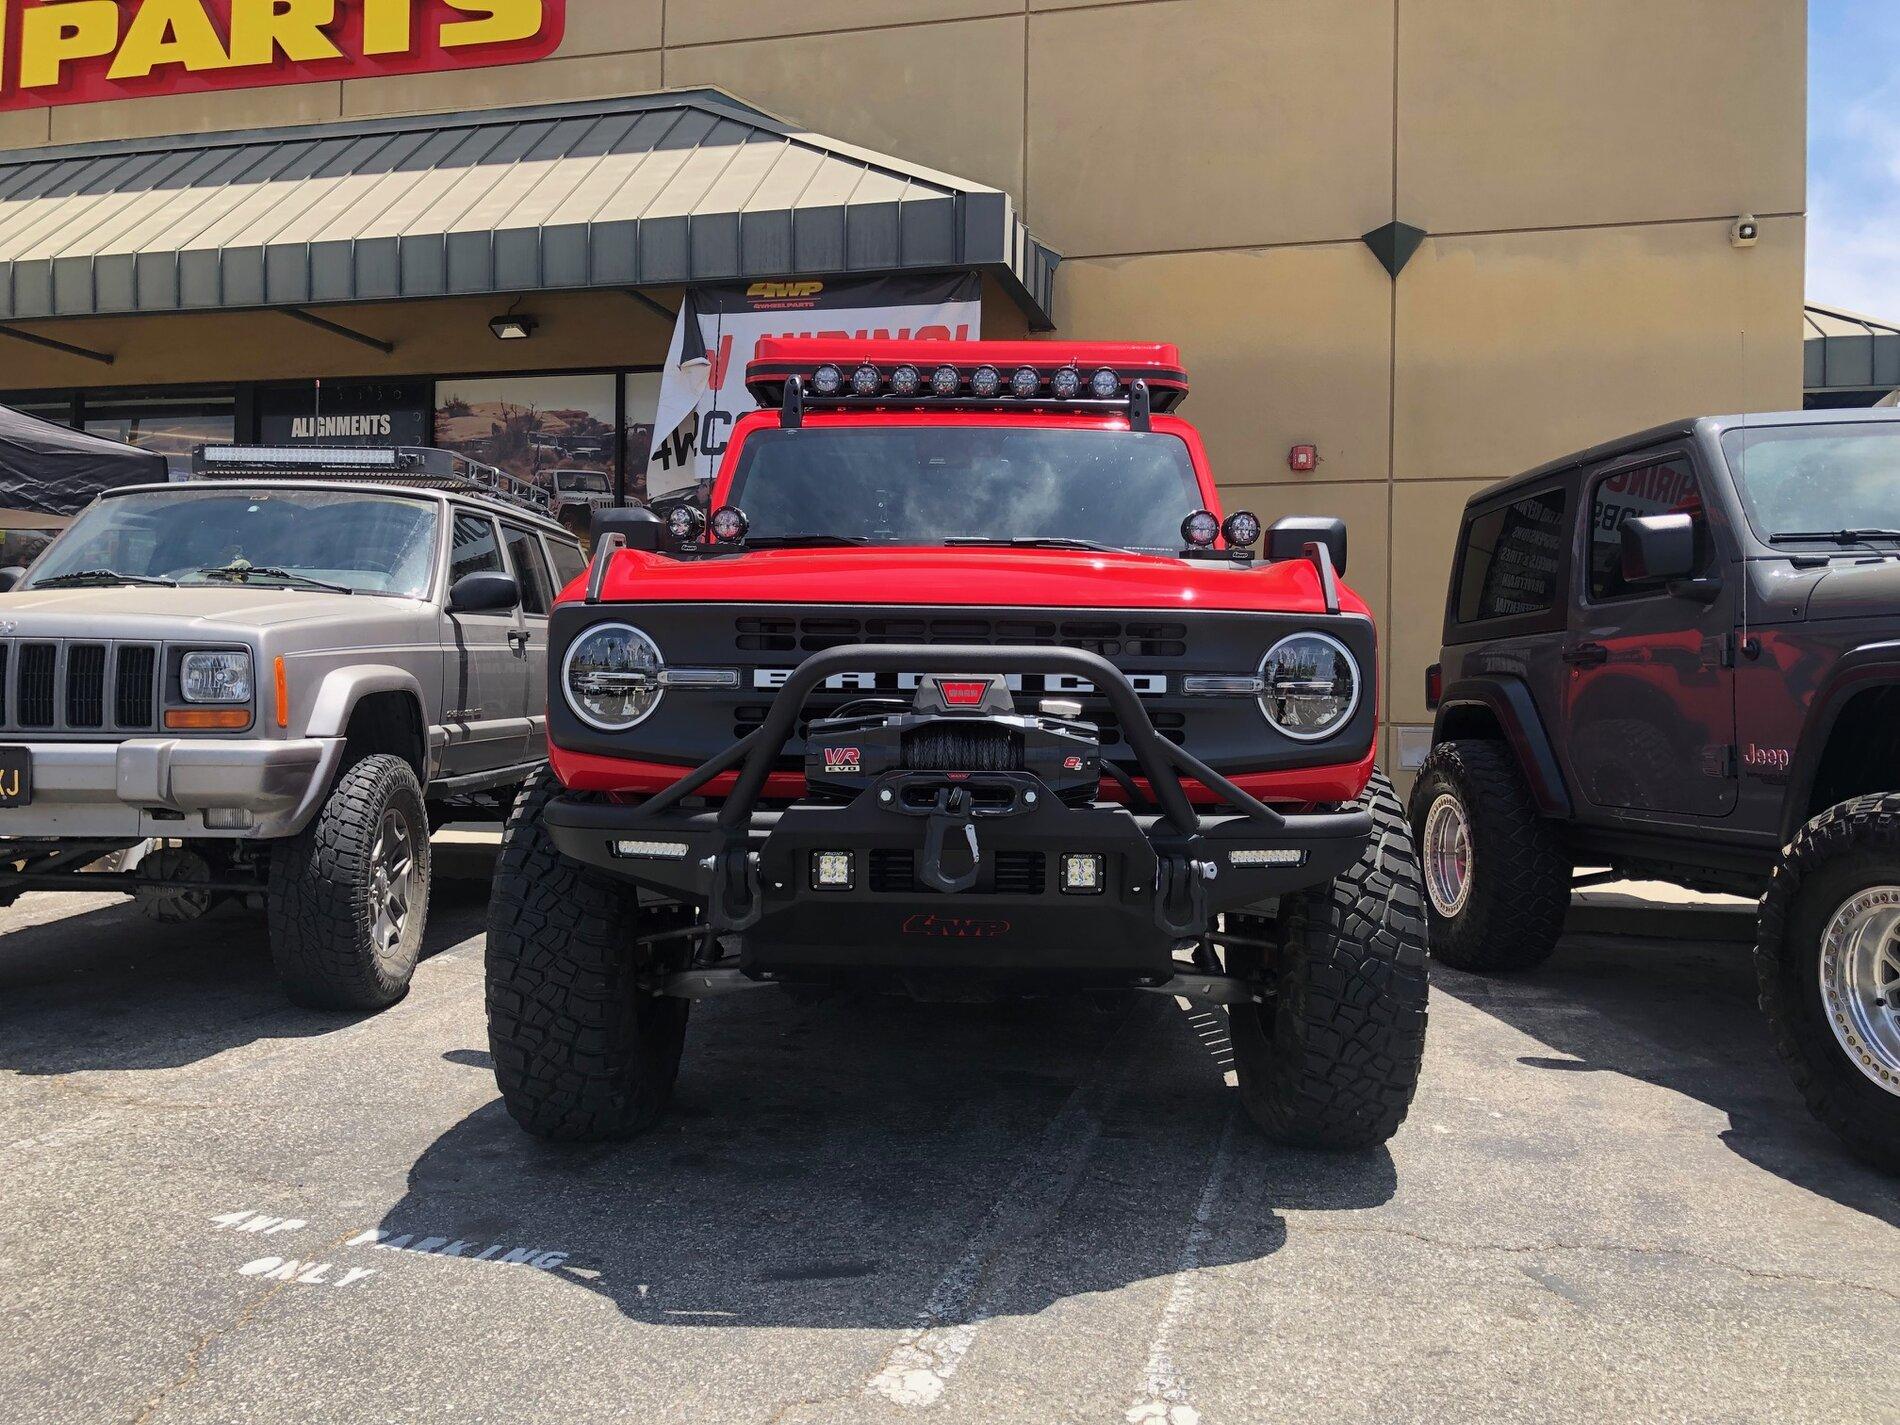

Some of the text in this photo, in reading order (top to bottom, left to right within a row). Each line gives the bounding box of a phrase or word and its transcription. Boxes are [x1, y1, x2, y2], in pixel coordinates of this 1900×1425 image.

[747, 282, 824, 298] 4WP
[291, 415, 392, 437] ALIGNMENTS
[824, 748, 860, 765] VR
[1743, 743, 1789, 771] Jeep
[345, 1229, 570, 1269] PARKING
[238, 1256, 377, 1288] ONLY
